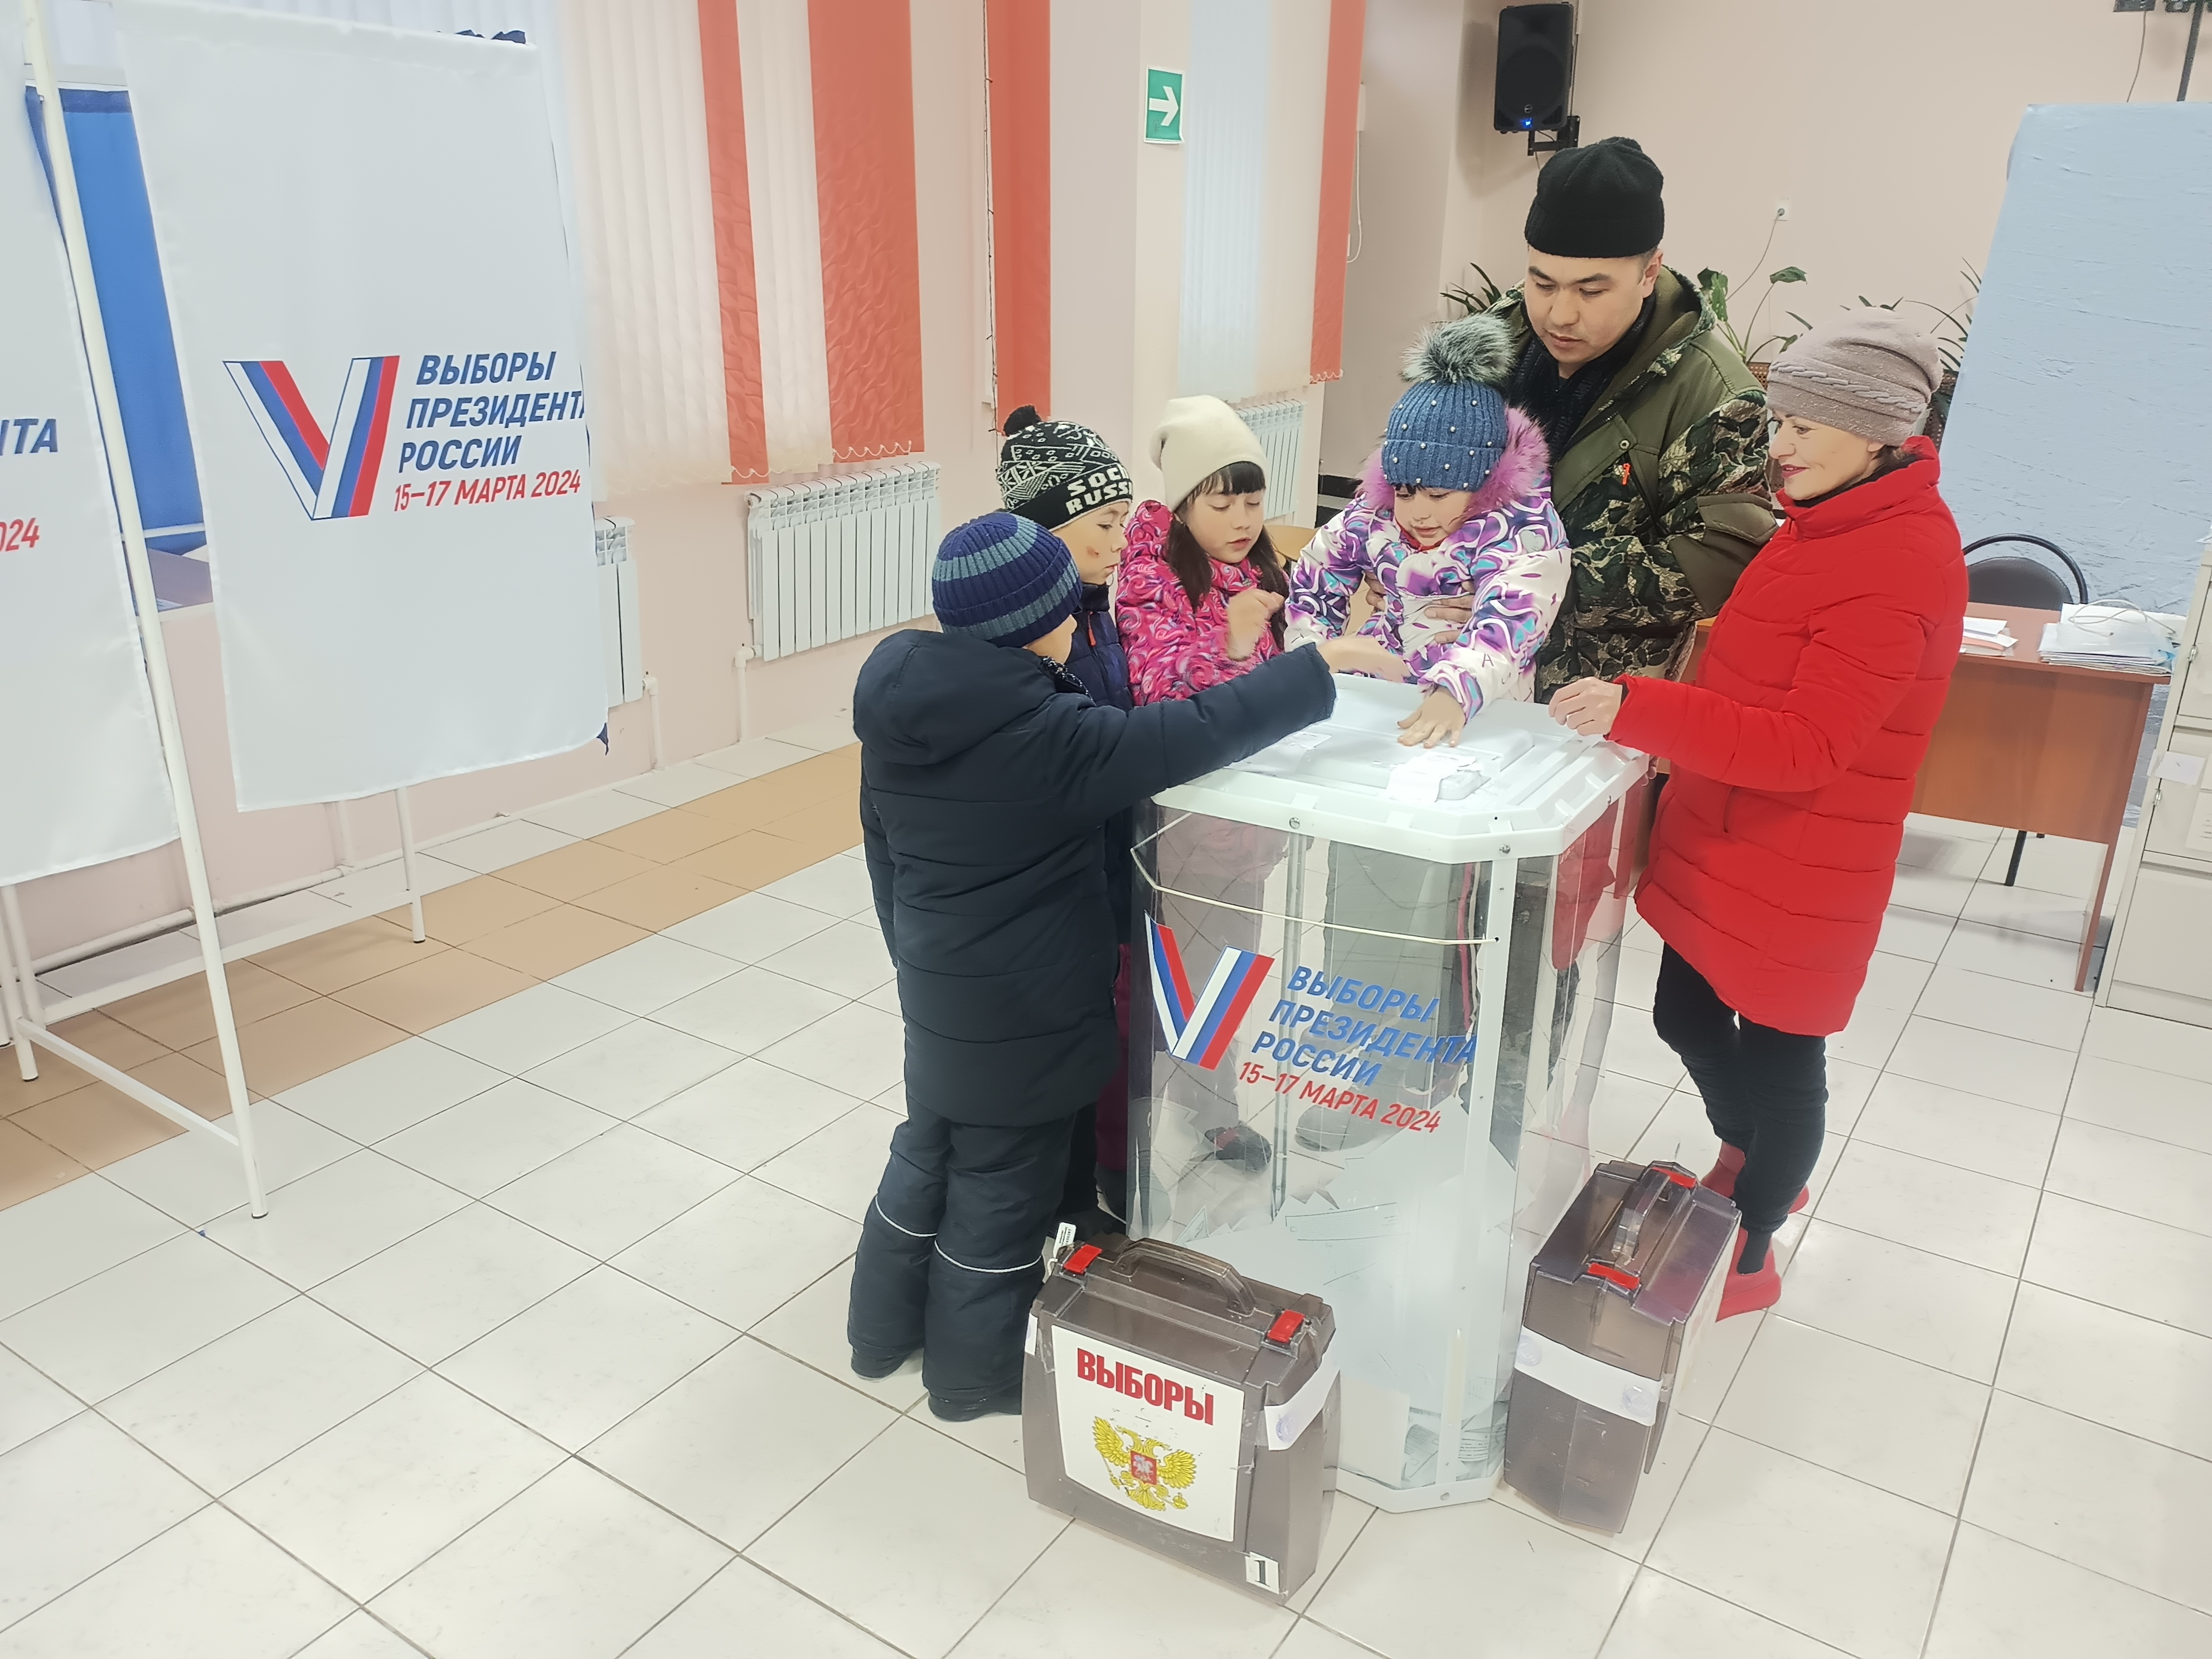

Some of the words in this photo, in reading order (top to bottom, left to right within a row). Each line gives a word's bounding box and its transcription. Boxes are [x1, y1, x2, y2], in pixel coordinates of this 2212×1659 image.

[416, 351, 557, 385] ВЫБОРЫ
[399, 435, 522, 473] РОССИИ
[454, 474, 527, 505] МАРТА
[531, 469, 581, 498] 2024
[1287, 966, 1440, 1022] ВЫБОРЫ
[1269, 999, 1477, 1064] ПРЕЗИДЕНТА
[1251, 1031, 1382, 1086] РОССИИ
[1299, 1080, 1381, 1120] МАРТА
[1380, 1103, 1441, 1133] 2024
[1078, 1347, 1214, 1426] ВЫБОРЫ
[1254, 1559, 1270, 1587] 1
